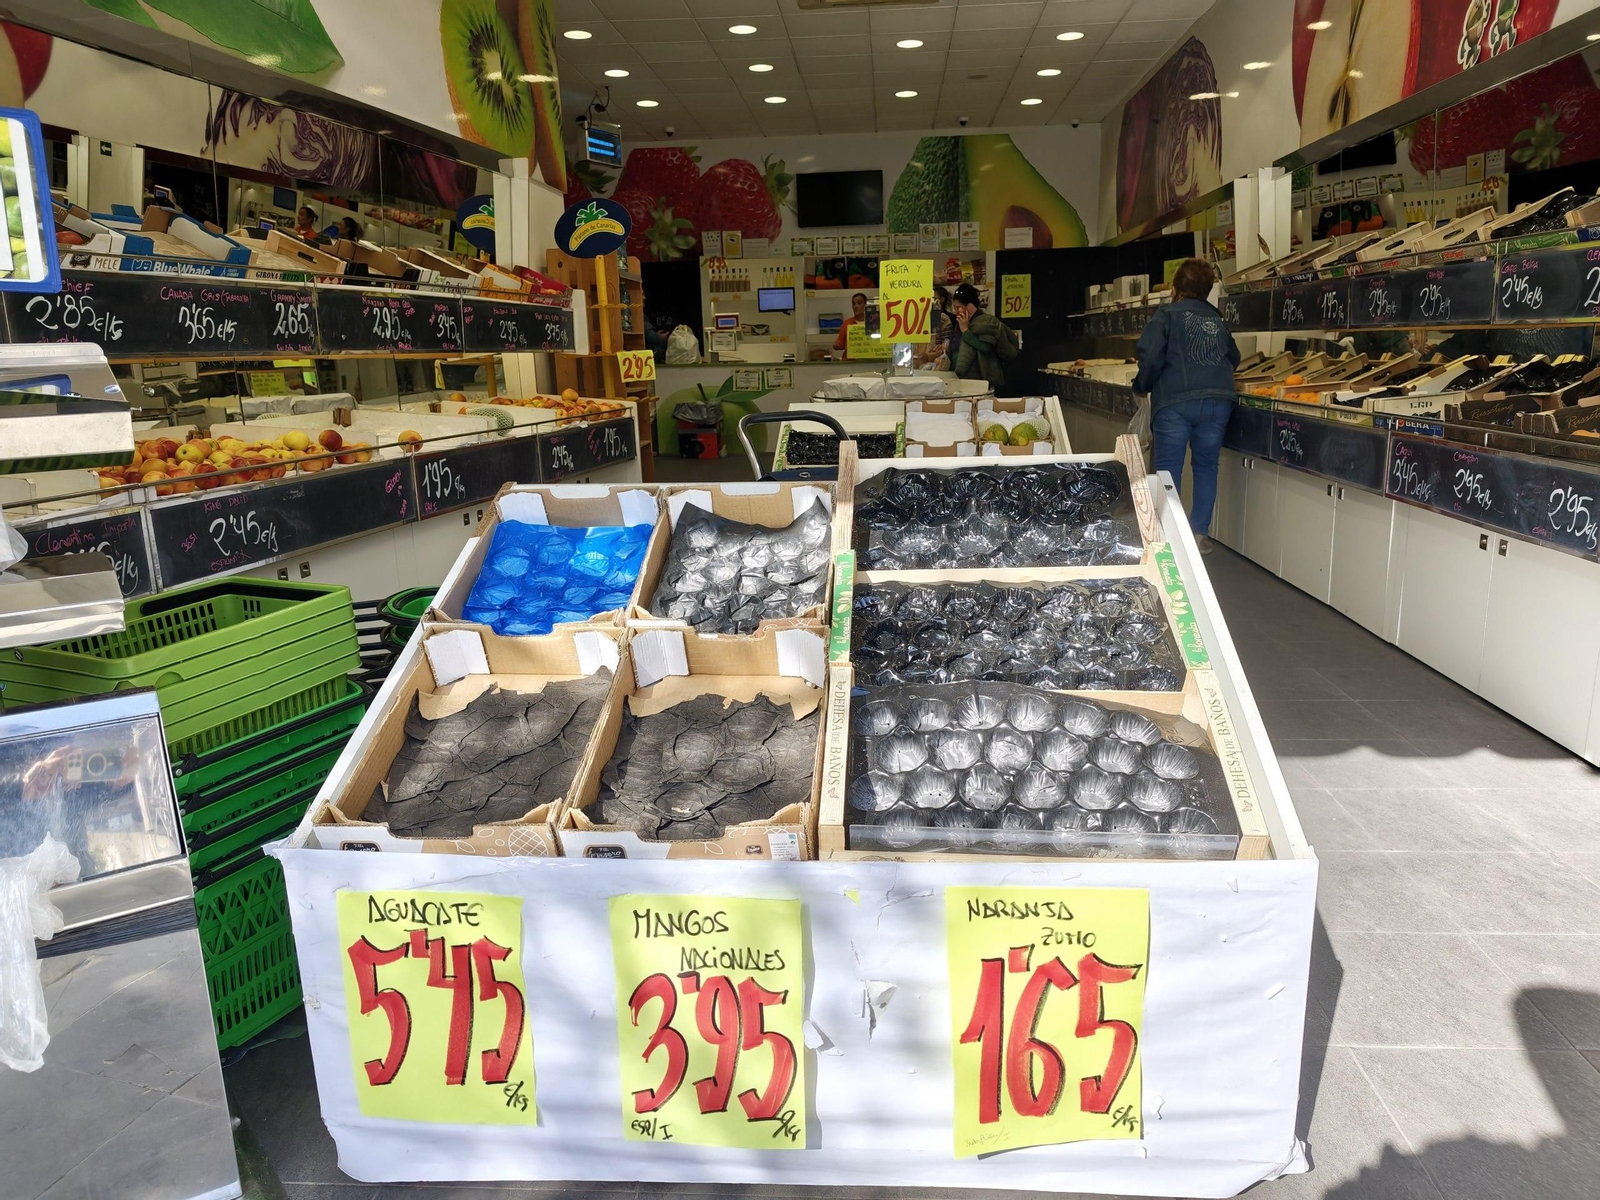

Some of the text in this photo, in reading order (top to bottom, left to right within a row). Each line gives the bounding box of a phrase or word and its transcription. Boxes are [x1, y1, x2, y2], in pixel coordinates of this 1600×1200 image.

[94, 257, 117, 269] MELE
[256, 271, 278, 280] GIRONA
[885, 263, 923, 276] FRUTA Y
[889, 279, 923, 289] VERDURA
[885, 297, 931, 338] 50%
[1004, 295, 1030, 313] 50%
[421, 458, 452, 499] 1'95
[828, 690, 846, 785] DEHESA DE BAÑOS
[1210, 699, 1251, 800] DEHESA DE BAÑOS
[368, 895, 484, 926] AGUACATE
[633, 908, 729, 939] MANGOS
[967, 898, 1074, 922] NARANJA
[1040, 926, 1097, 948] ZUMO
[347, 928, 525, 1086] 5'45
[628, 971, 798, 1122] 3'95
[959, 944, 1143, 1124] 1'65
